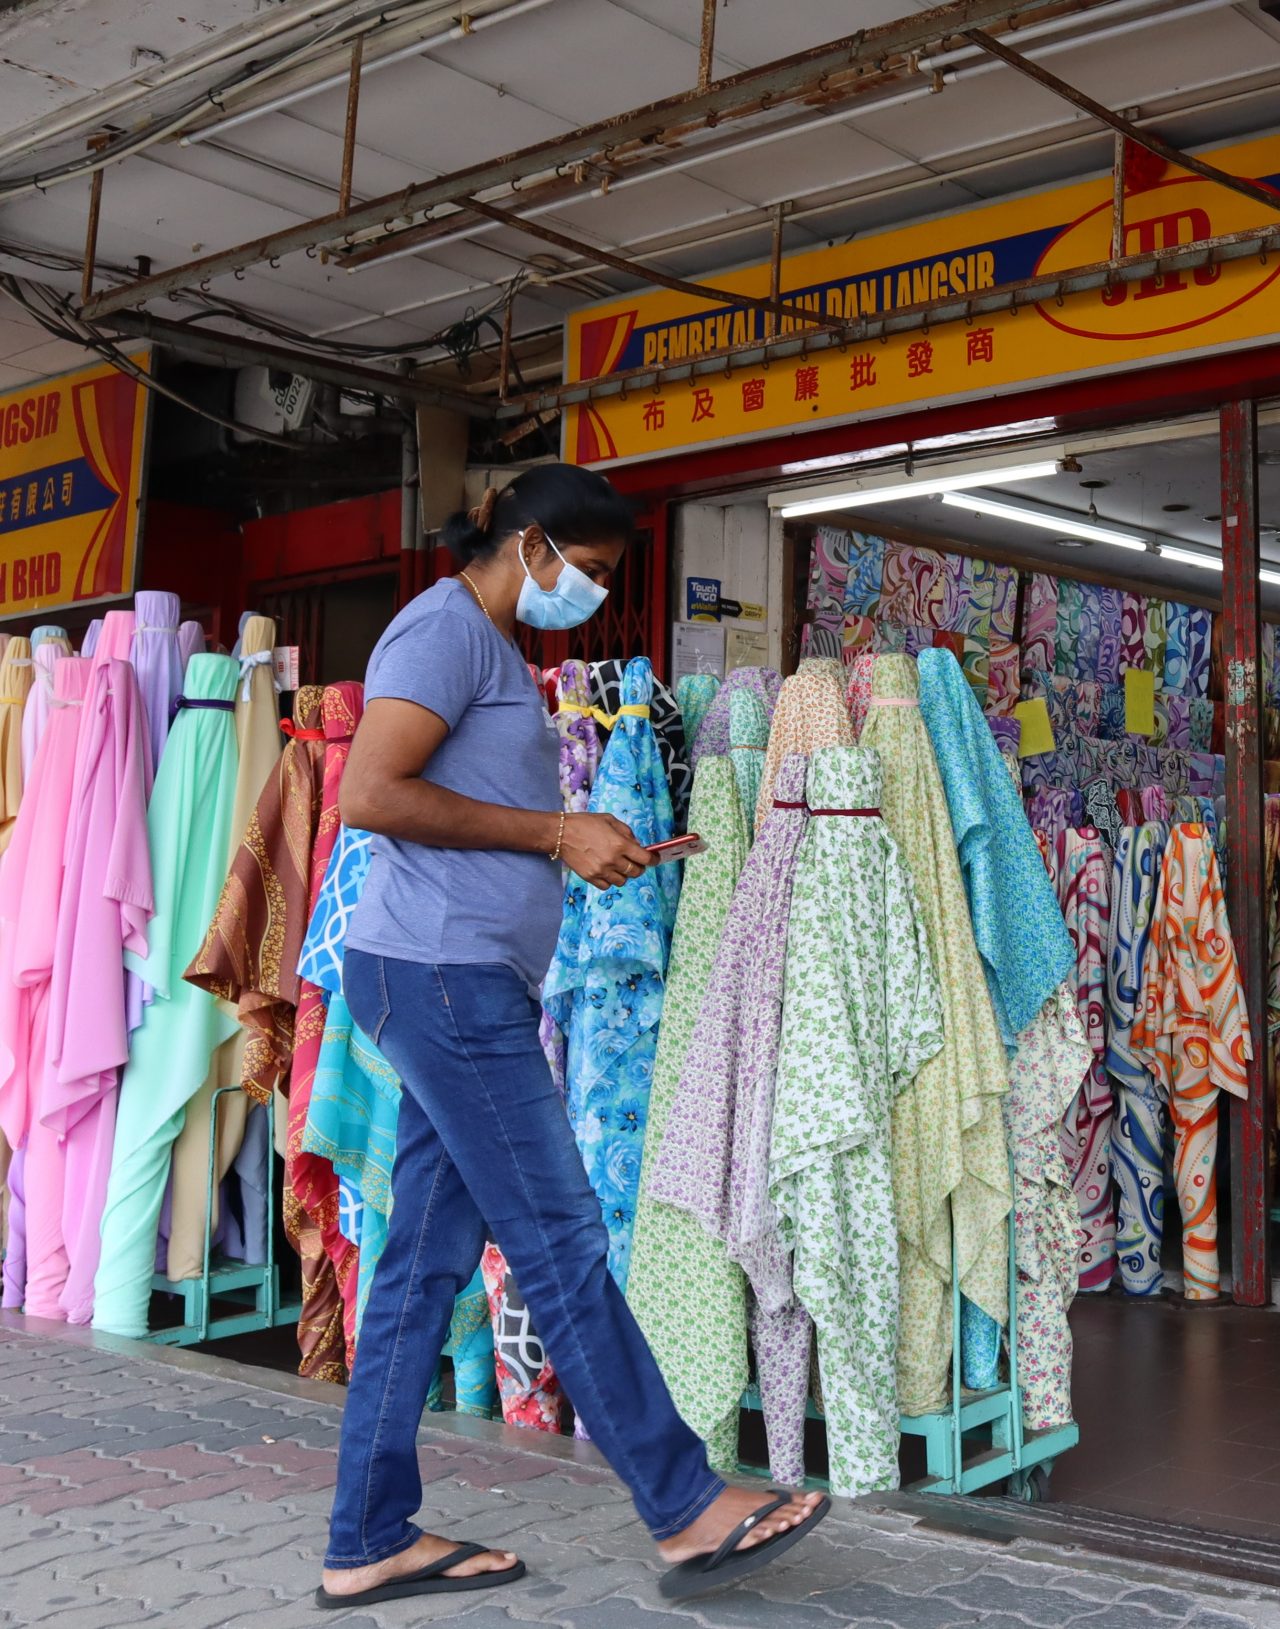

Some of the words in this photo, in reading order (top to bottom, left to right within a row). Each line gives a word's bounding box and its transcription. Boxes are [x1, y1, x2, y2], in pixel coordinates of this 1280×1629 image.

[643, 328, 995, 431] 布及窗簾批發商
[12, 552, 61, 602] BHD
[691, 582, 718, 593] Touch
